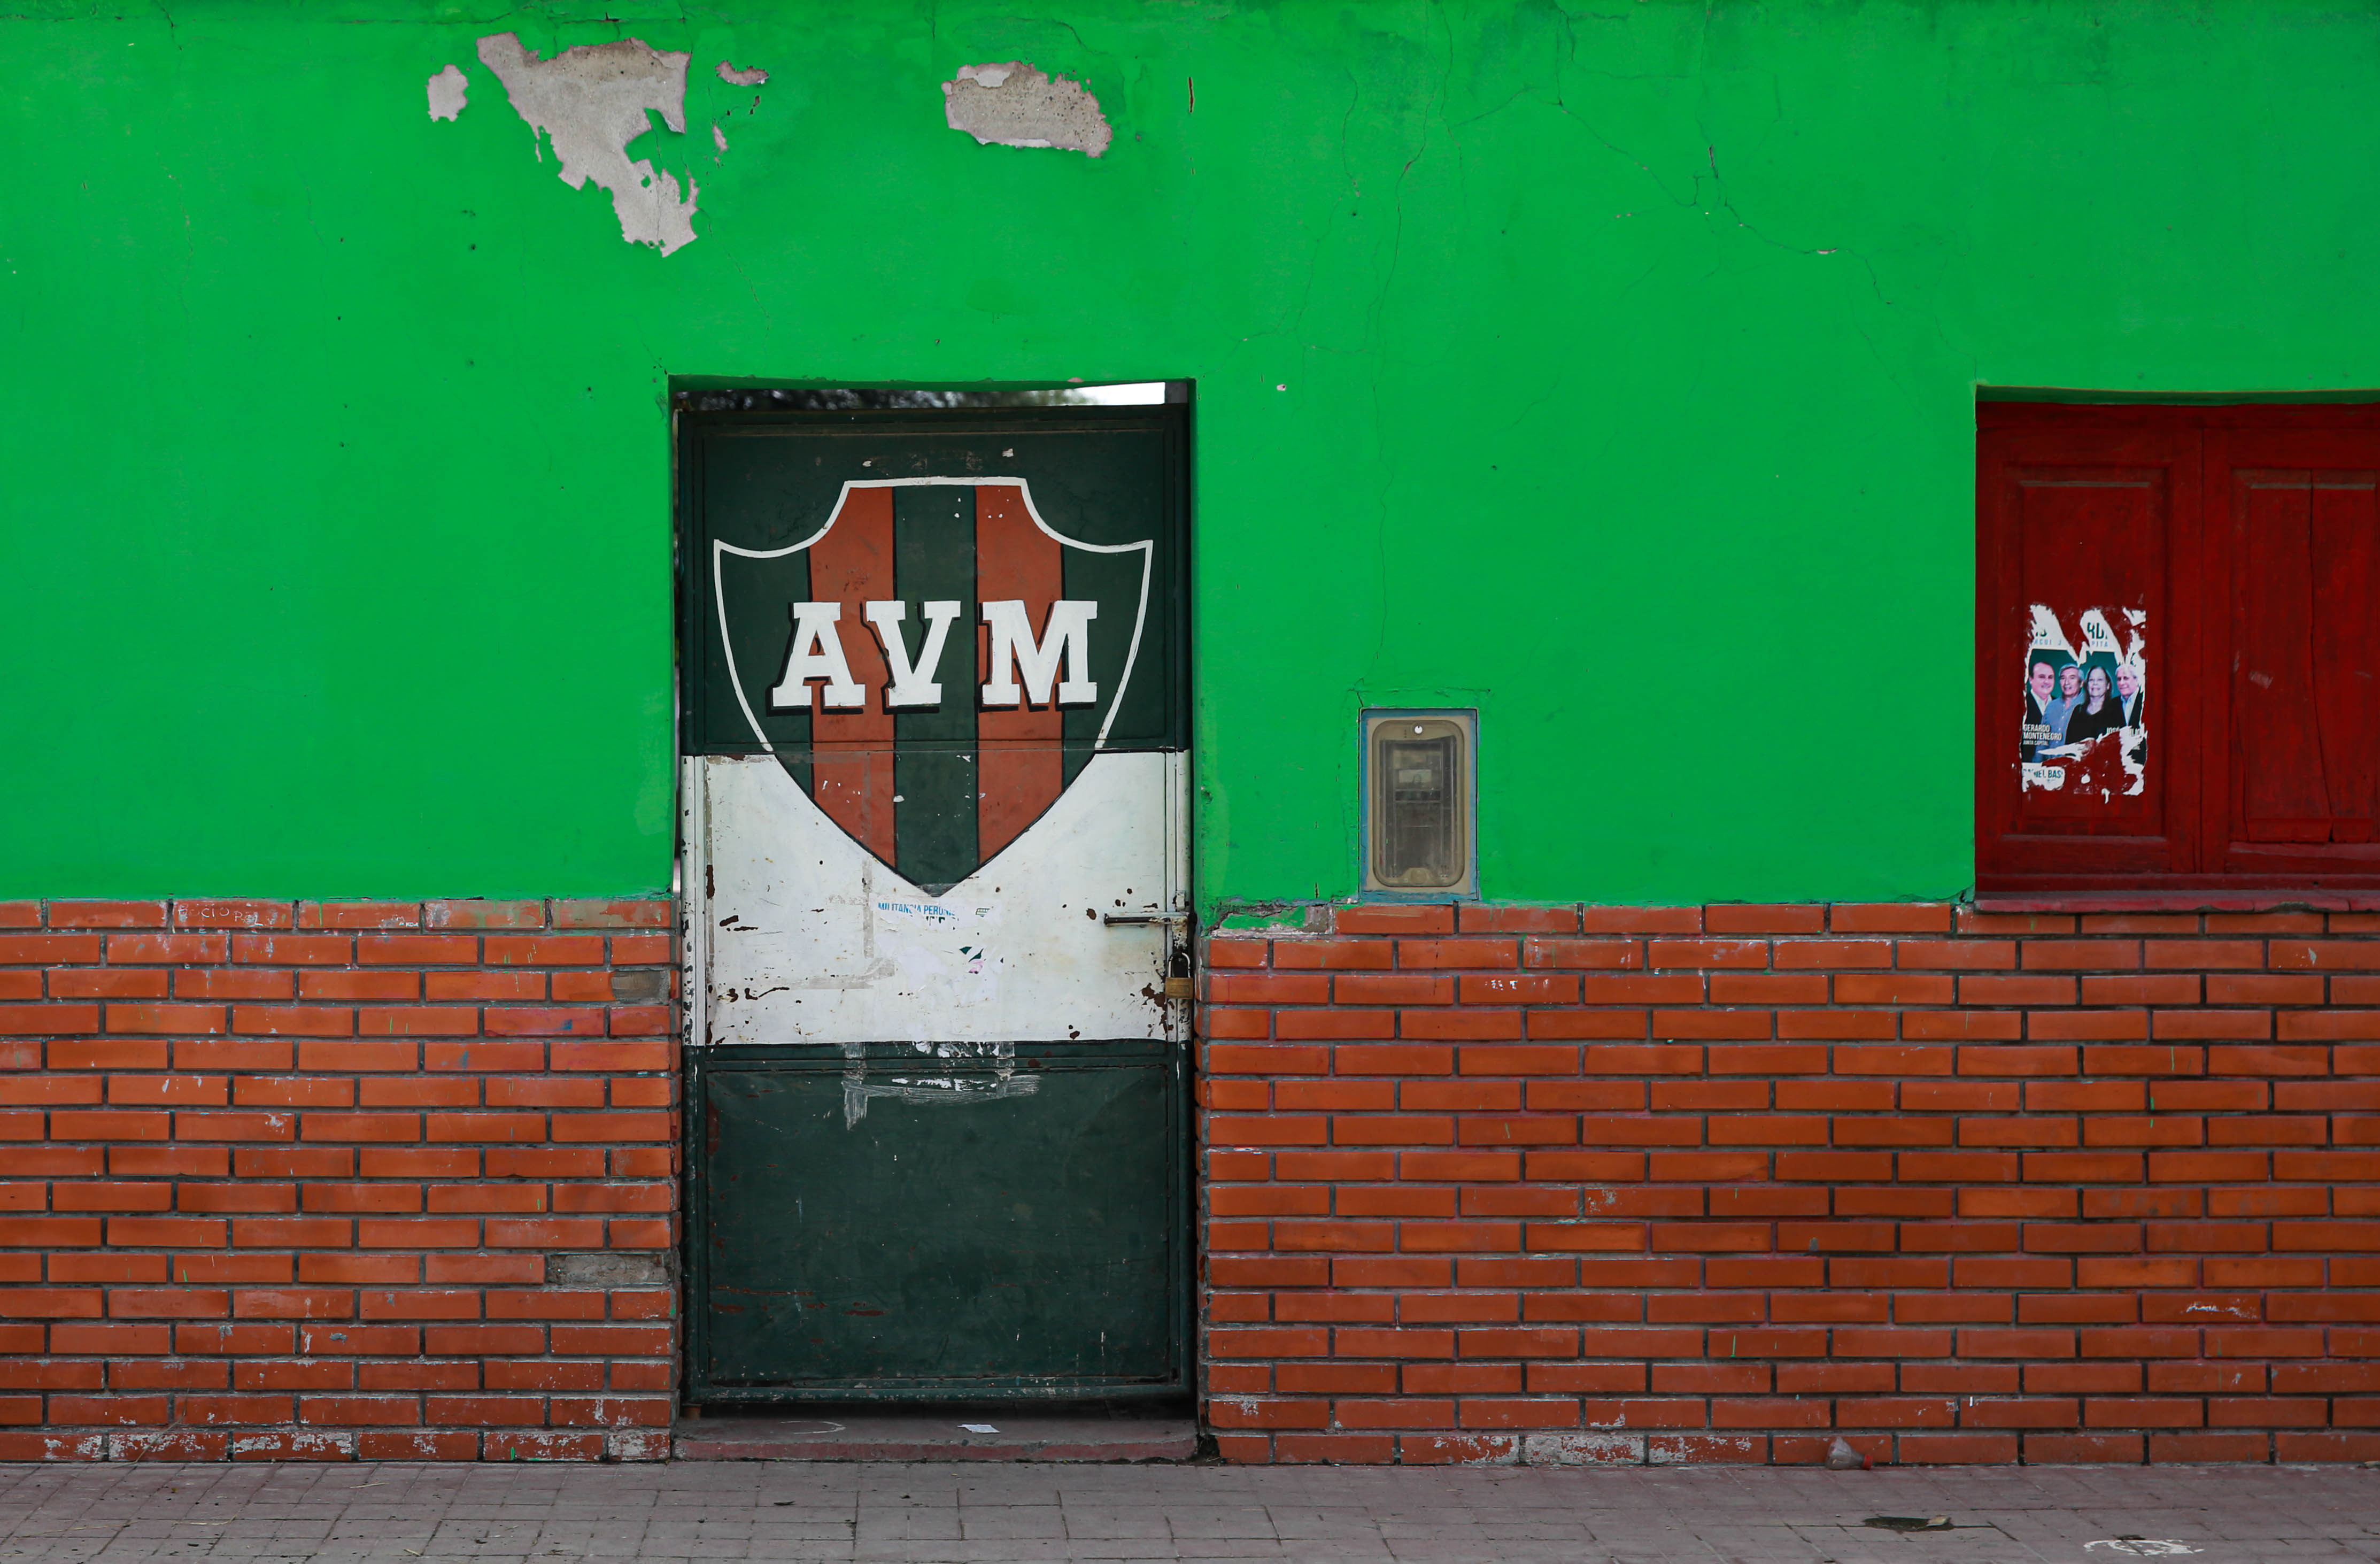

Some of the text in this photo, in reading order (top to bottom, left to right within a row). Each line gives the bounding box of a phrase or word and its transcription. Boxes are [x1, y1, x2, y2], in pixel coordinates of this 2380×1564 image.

[770, 599, 1098, 709] AVM
[2023, 723, 2051, 733] GERARDO
[2023, 731, 2062, 741] MONTENEGRO
[2047, 769, 2064, 779] BAS
